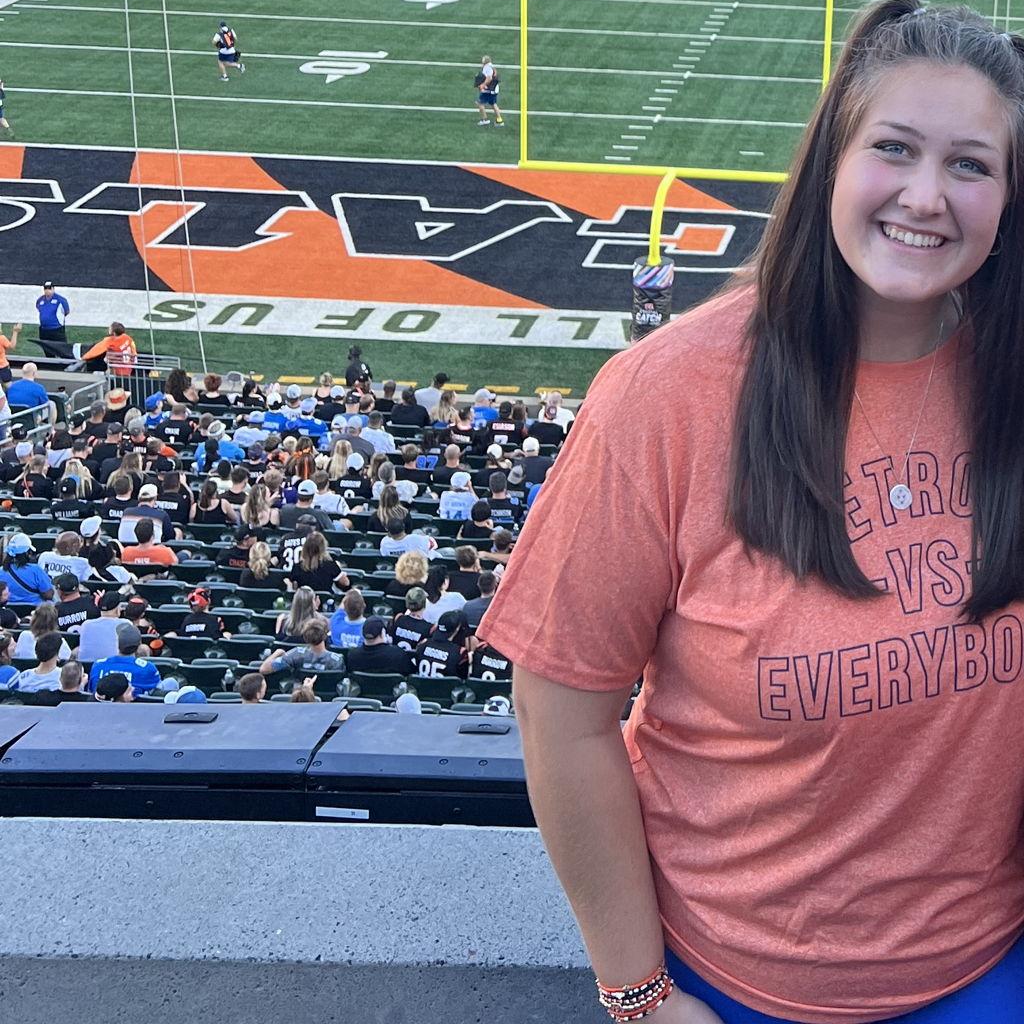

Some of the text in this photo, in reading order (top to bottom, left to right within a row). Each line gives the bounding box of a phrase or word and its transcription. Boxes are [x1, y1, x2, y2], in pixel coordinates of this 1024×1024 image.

[143, 298, 636, 345] LL OF US
[416, 455, 439, 470] 97
[843, 451, 974, 544] ETRO
[58, 610, 88, 626] BURROW
[418, 659, 447, 678] 85
